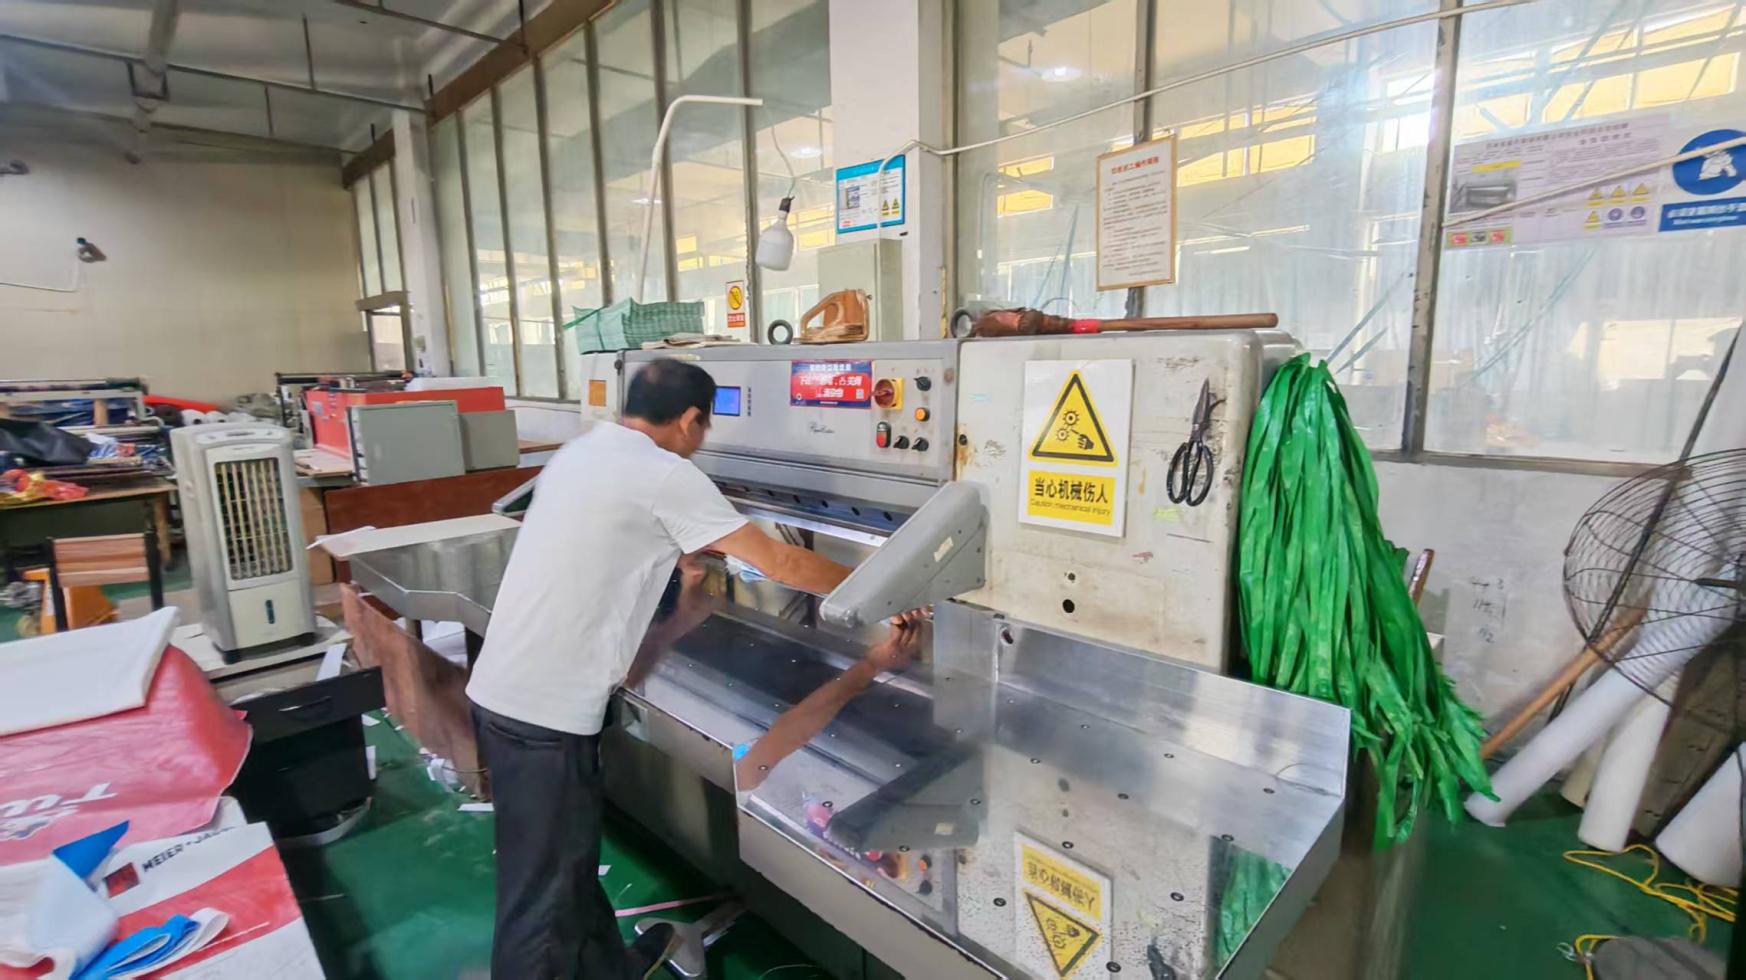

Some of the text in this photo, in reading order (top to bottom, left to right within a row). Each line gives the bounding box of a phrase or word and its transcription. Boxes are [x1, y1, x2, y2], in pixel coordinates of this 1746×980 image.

[1035, 477, 1108, 504] 当心机械伤人
[142, 844, 184, 872] MEIER
